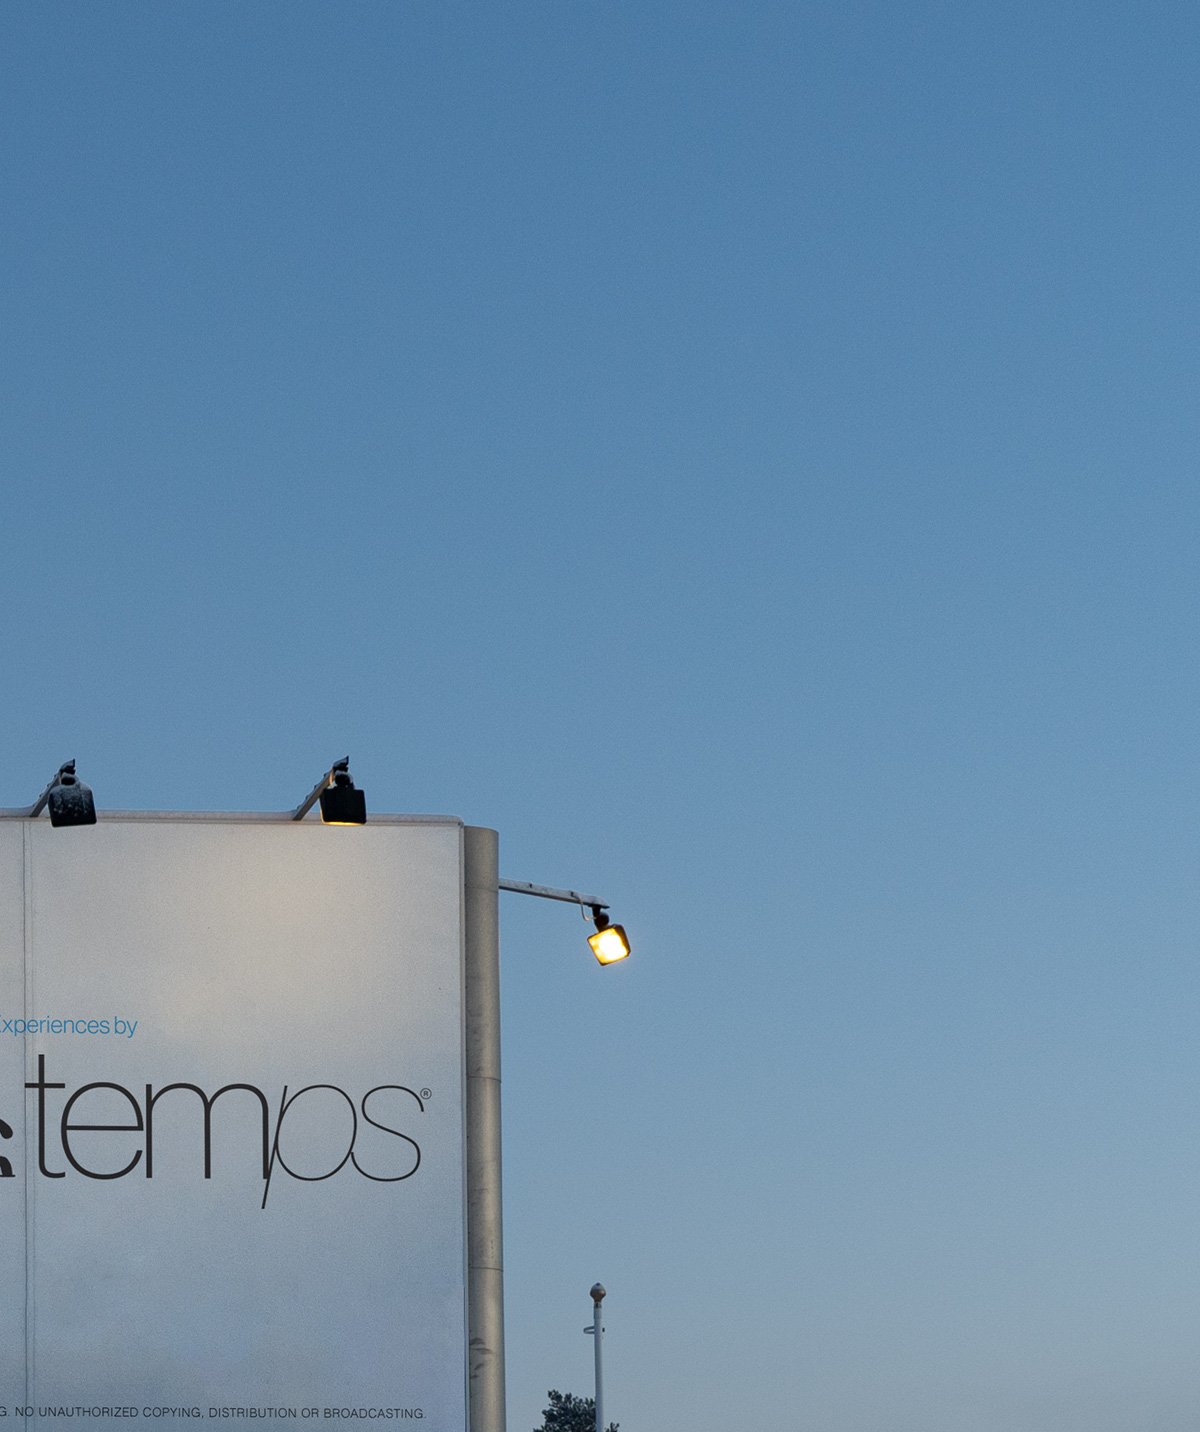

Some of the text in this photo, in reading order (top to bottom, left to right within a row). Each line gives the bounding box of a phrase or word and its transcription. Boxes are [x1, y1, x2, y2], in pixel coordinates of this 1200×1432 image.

[114, 1016, 138, 1038] by
[15, 1406, 34, 1417] NO
[39, 1406, 139, 1418] UNAUTHORIZED
[143, 1407, 205, 1419] COPYING,
[209, 1407, 297, 1418] DISTRIBUTION
[301, 1408, 319, 1418] OR
[323, 1407, 426, 1419] BROADCASTING.
